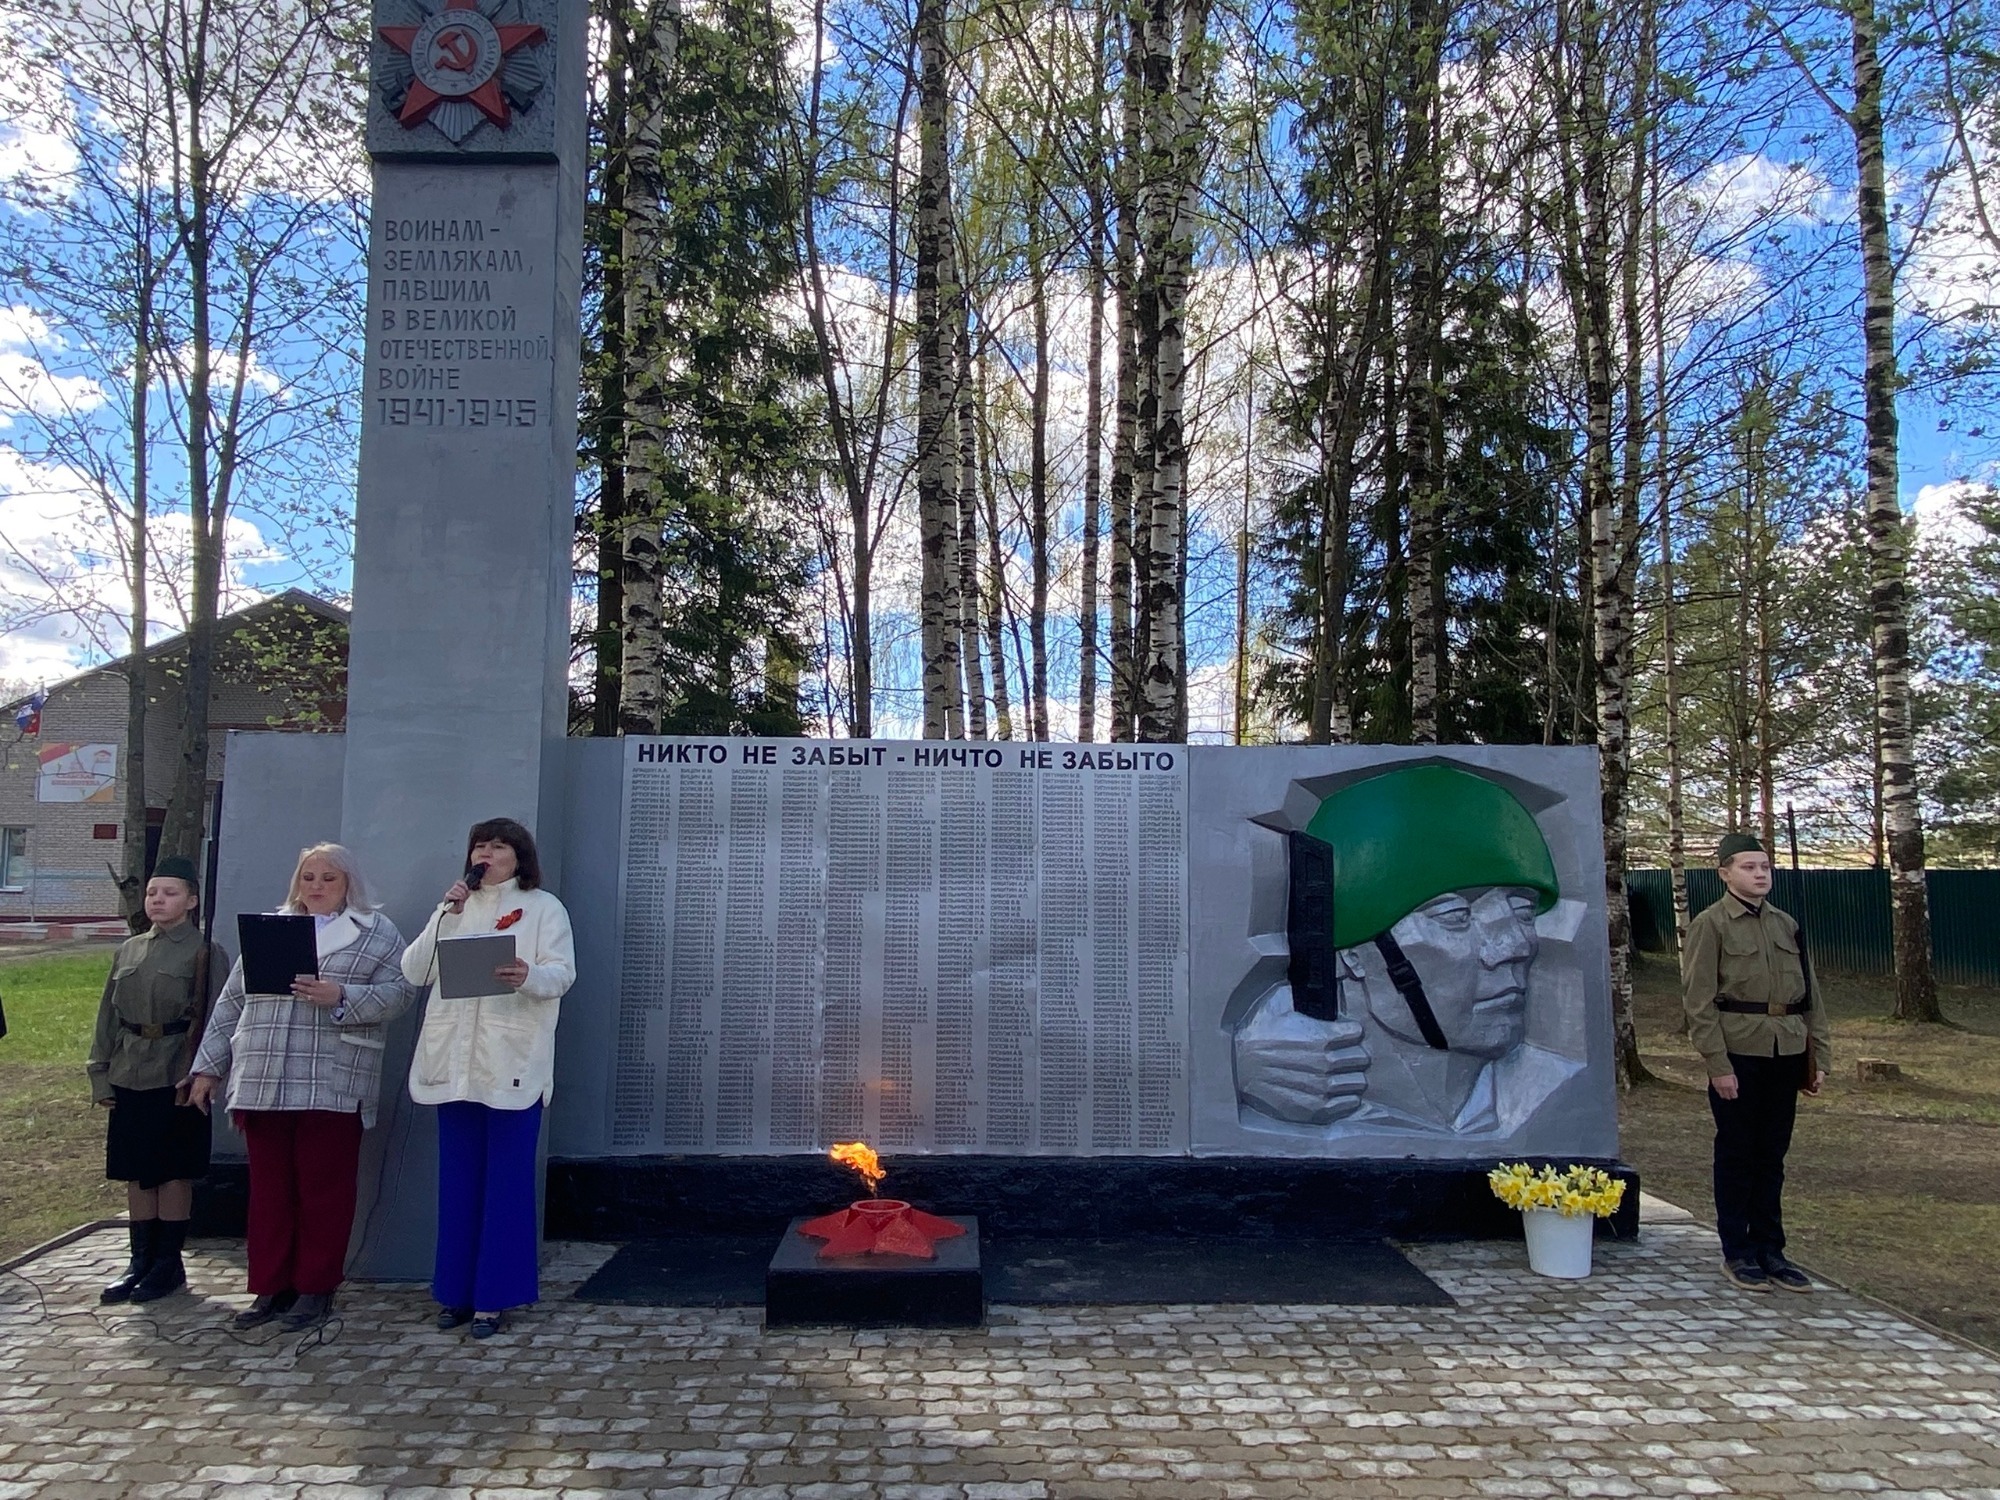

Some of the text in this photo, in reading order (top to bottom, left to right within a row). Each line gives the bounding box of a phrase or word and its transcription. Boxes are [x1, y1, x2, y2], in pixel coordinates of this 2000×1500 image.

[383, 250, 533, 275] ЗЕМЛЯКАМ,
[382, 279, 491, 301] ПАВШИМ
[381, 305, 516, 331] В ВЕЛИКОЙ
[380, 336, 549, 360] ОТЕЧЕСТВЕННОЙ
[379, 364, 460, 390] ВОЙНЕ
[638, 743, 728, 764] НИКТО
[742, 745, 777, 765] НЕ
[791, 746, 887, 766] ЗАБЫТ
[914, 747, 1003, 768] НИЧТО
[1020, 749, 1053, 769] НЕ
[1062, 750, 1174, 771] ЗАБЫТО
